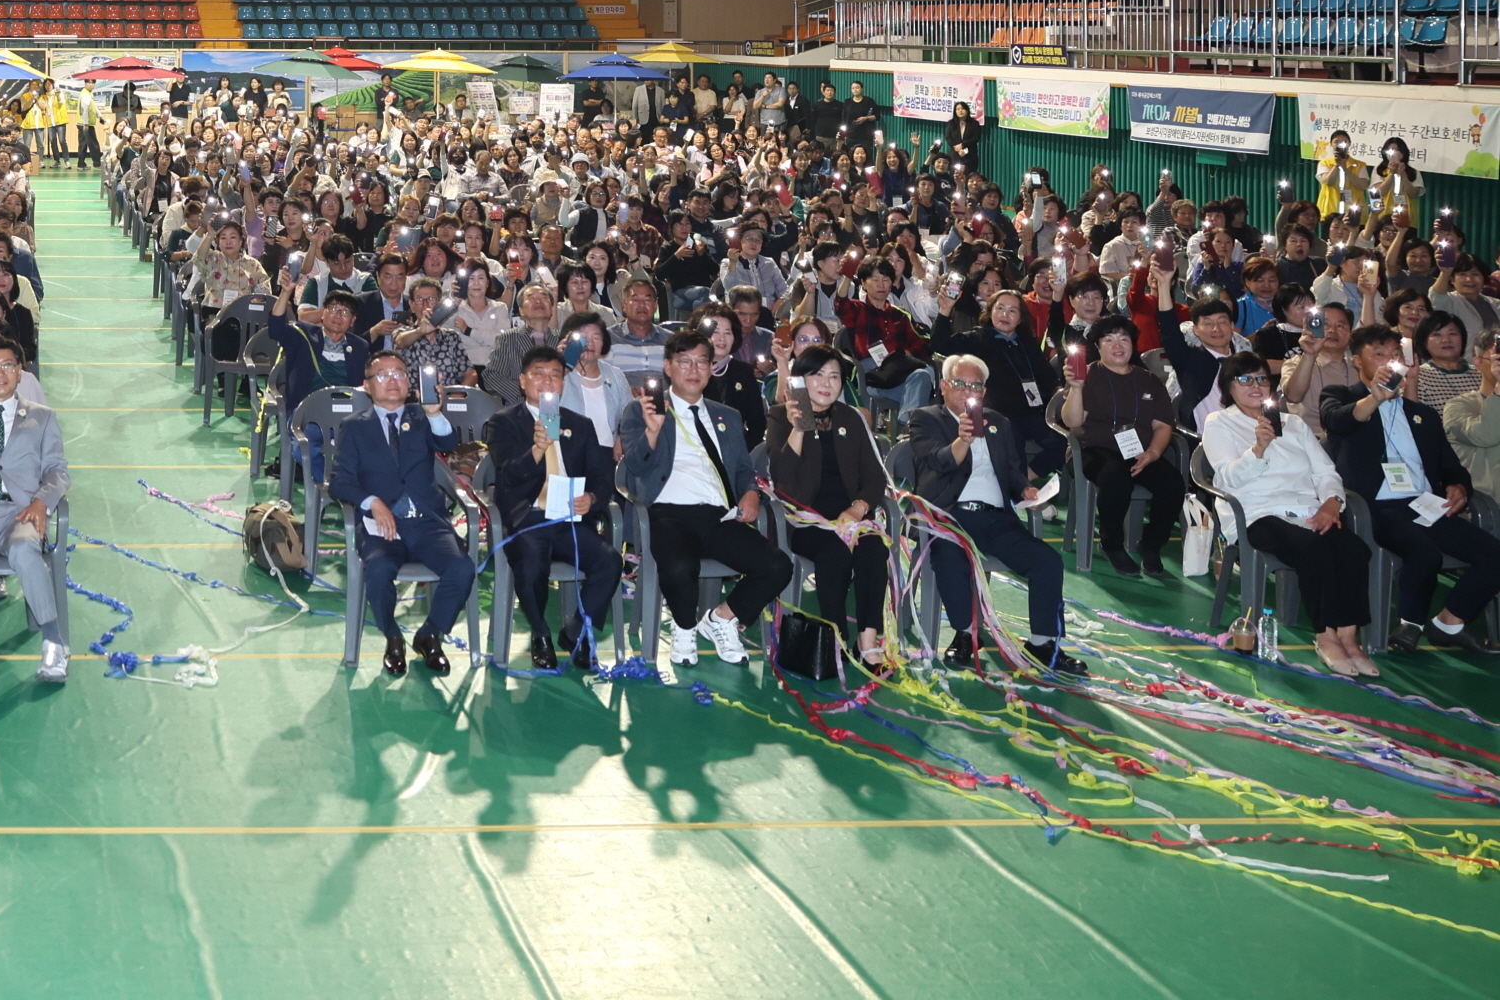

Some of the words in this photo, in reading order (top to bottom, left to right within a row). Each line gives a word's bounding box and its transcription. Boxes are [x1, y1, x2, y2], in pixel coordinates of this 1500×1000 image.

[915, 84, 929, 96] 행복과
[943, 86, 958, 99] 가득한
[1011, 91, 1036, 104] 어르신들의
[1037, 93, 1060, 105] 편안하고
[1061, 95, 1078, 107] 행복한
[1078, 96, 1091, 108] 삶을
[905, 96, 952, 113] 보성군립노인요양원
[1016, 105, 1036, 117] 함께하는
[1142, 104, 1171, 121] 차이가
[1173, 105, 1203, 124] 차별을
[1207, 113, 1224, 126] 만들지
[1224, 115, 1237, 127] 않는
[1237, 115, 1251, 128] 세상
[1316, 117, 1340, 131] 행복과
[1341, 119, 1367, 134] 건강을
[1369, 122, 1407, 137] 지켜주는
[1409, 125, 1471, 143] 주간보호센터
[1220, 135, 1230, 144] 함께
[1230, 136, 1245, 145] 합니다
